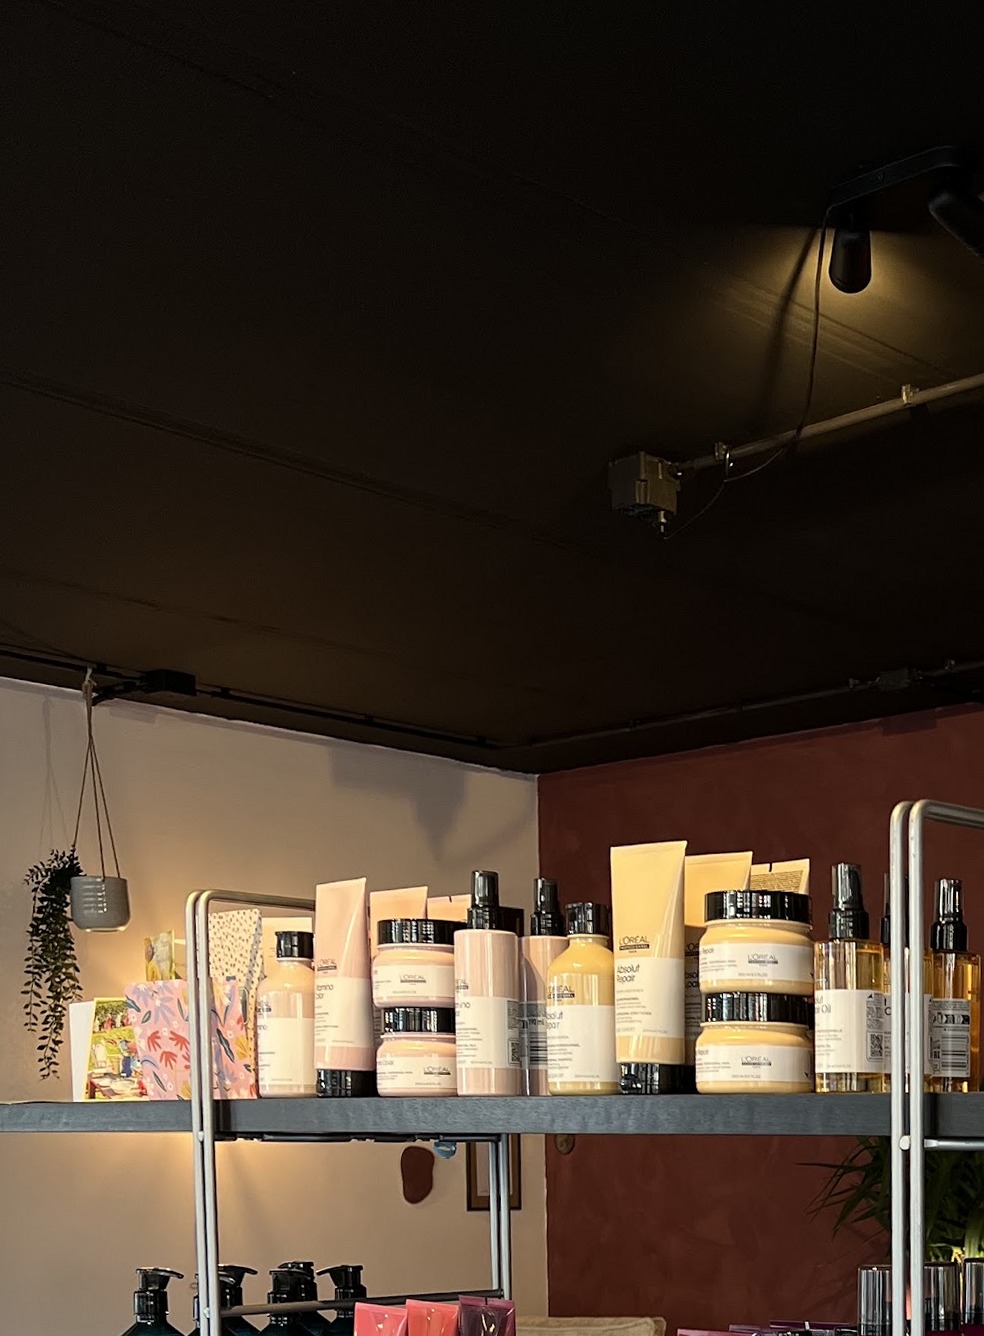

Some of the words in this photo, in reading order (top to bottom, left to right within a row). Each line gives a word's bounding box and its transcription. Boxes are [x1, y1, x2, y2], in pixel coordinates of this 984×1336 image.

[619, 935, 649, 945] L'ORÉAL
[617, 964, 640, 974] Absolut
[617, 973, 635, 985] Repair
